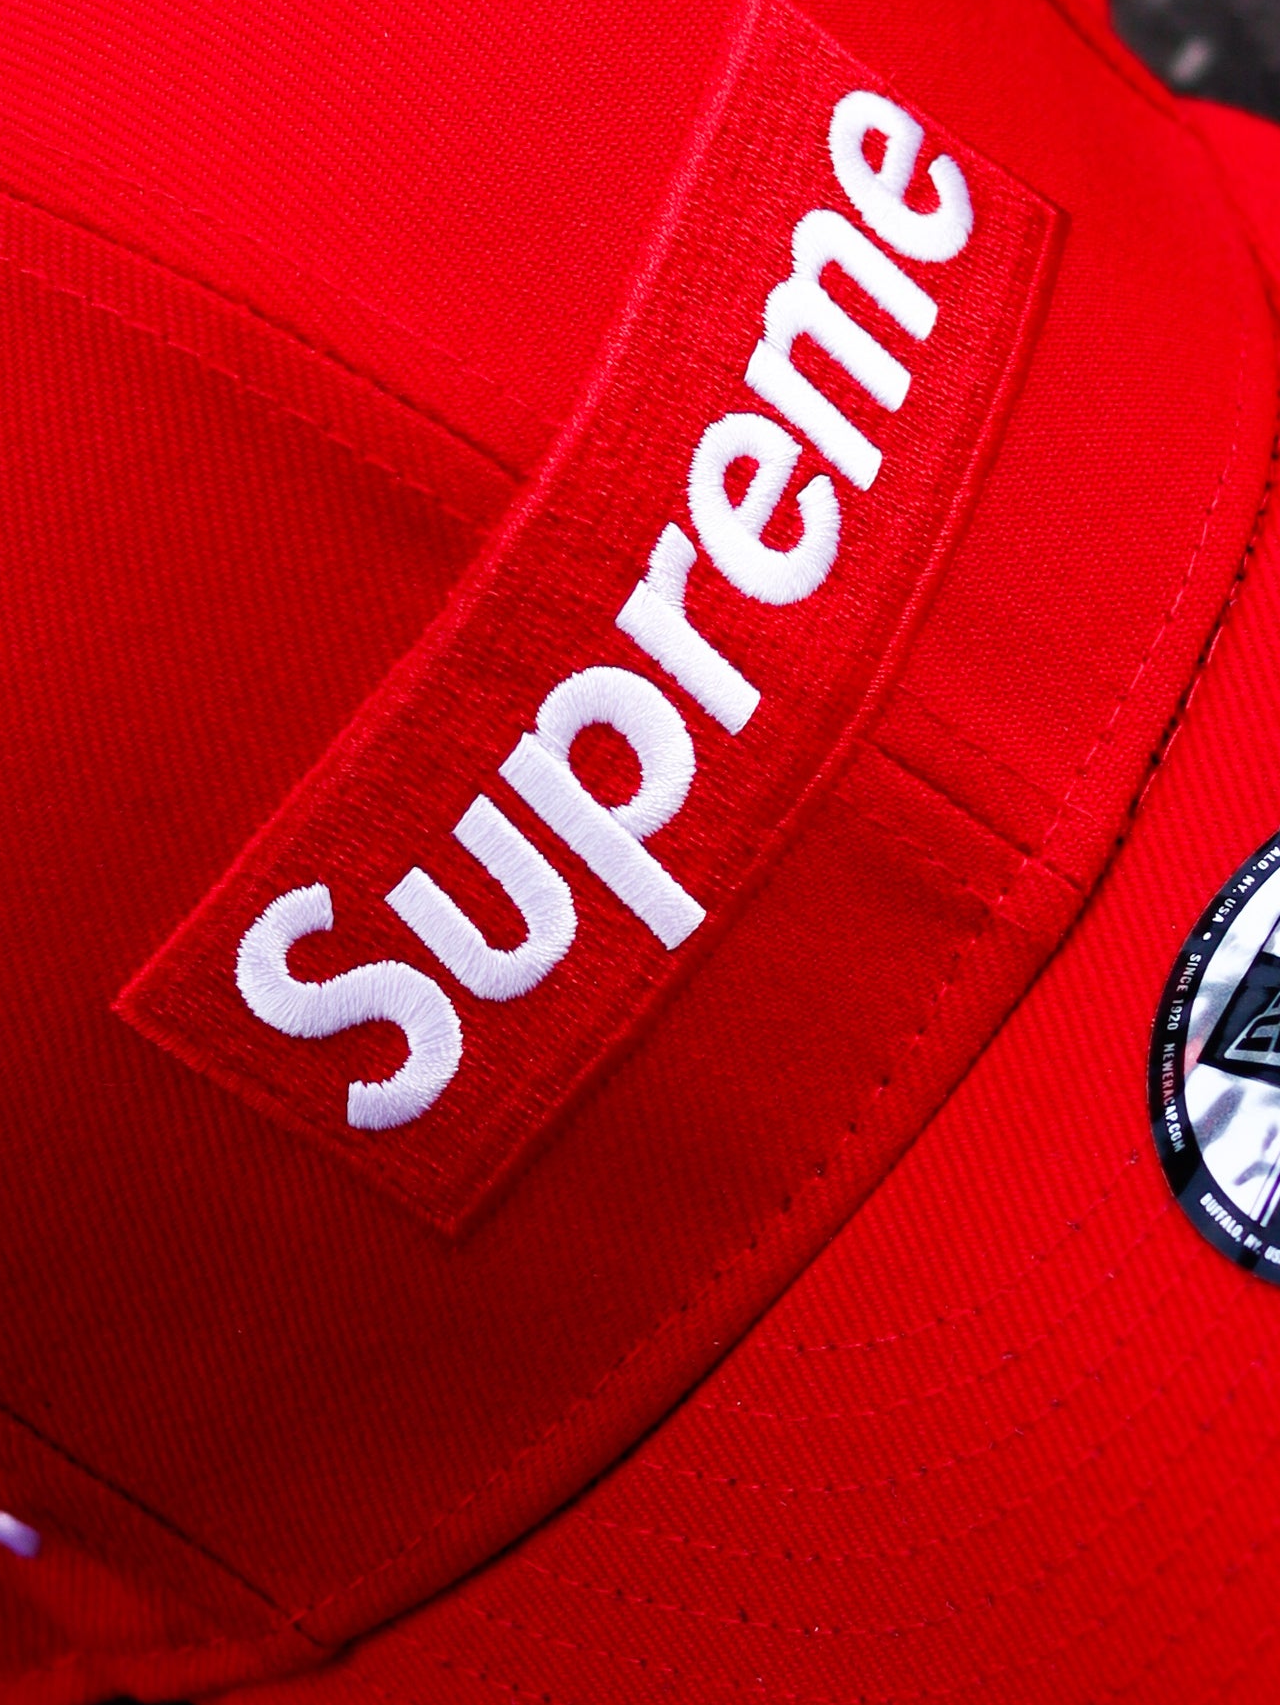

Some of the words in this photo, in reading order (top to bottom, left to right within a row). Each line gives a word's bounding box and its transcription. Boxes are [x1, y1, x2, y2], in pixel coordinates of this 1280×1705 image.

[235, 90, 975, 1131] Supreme
[1212, 898, 1236, 923] USA
[1176, 953, 1201, 992] SINCE
[1167, 998, 1184, 1031] 1920
[1162, 1043, 1185, 1153] NEWERACAP.COM
